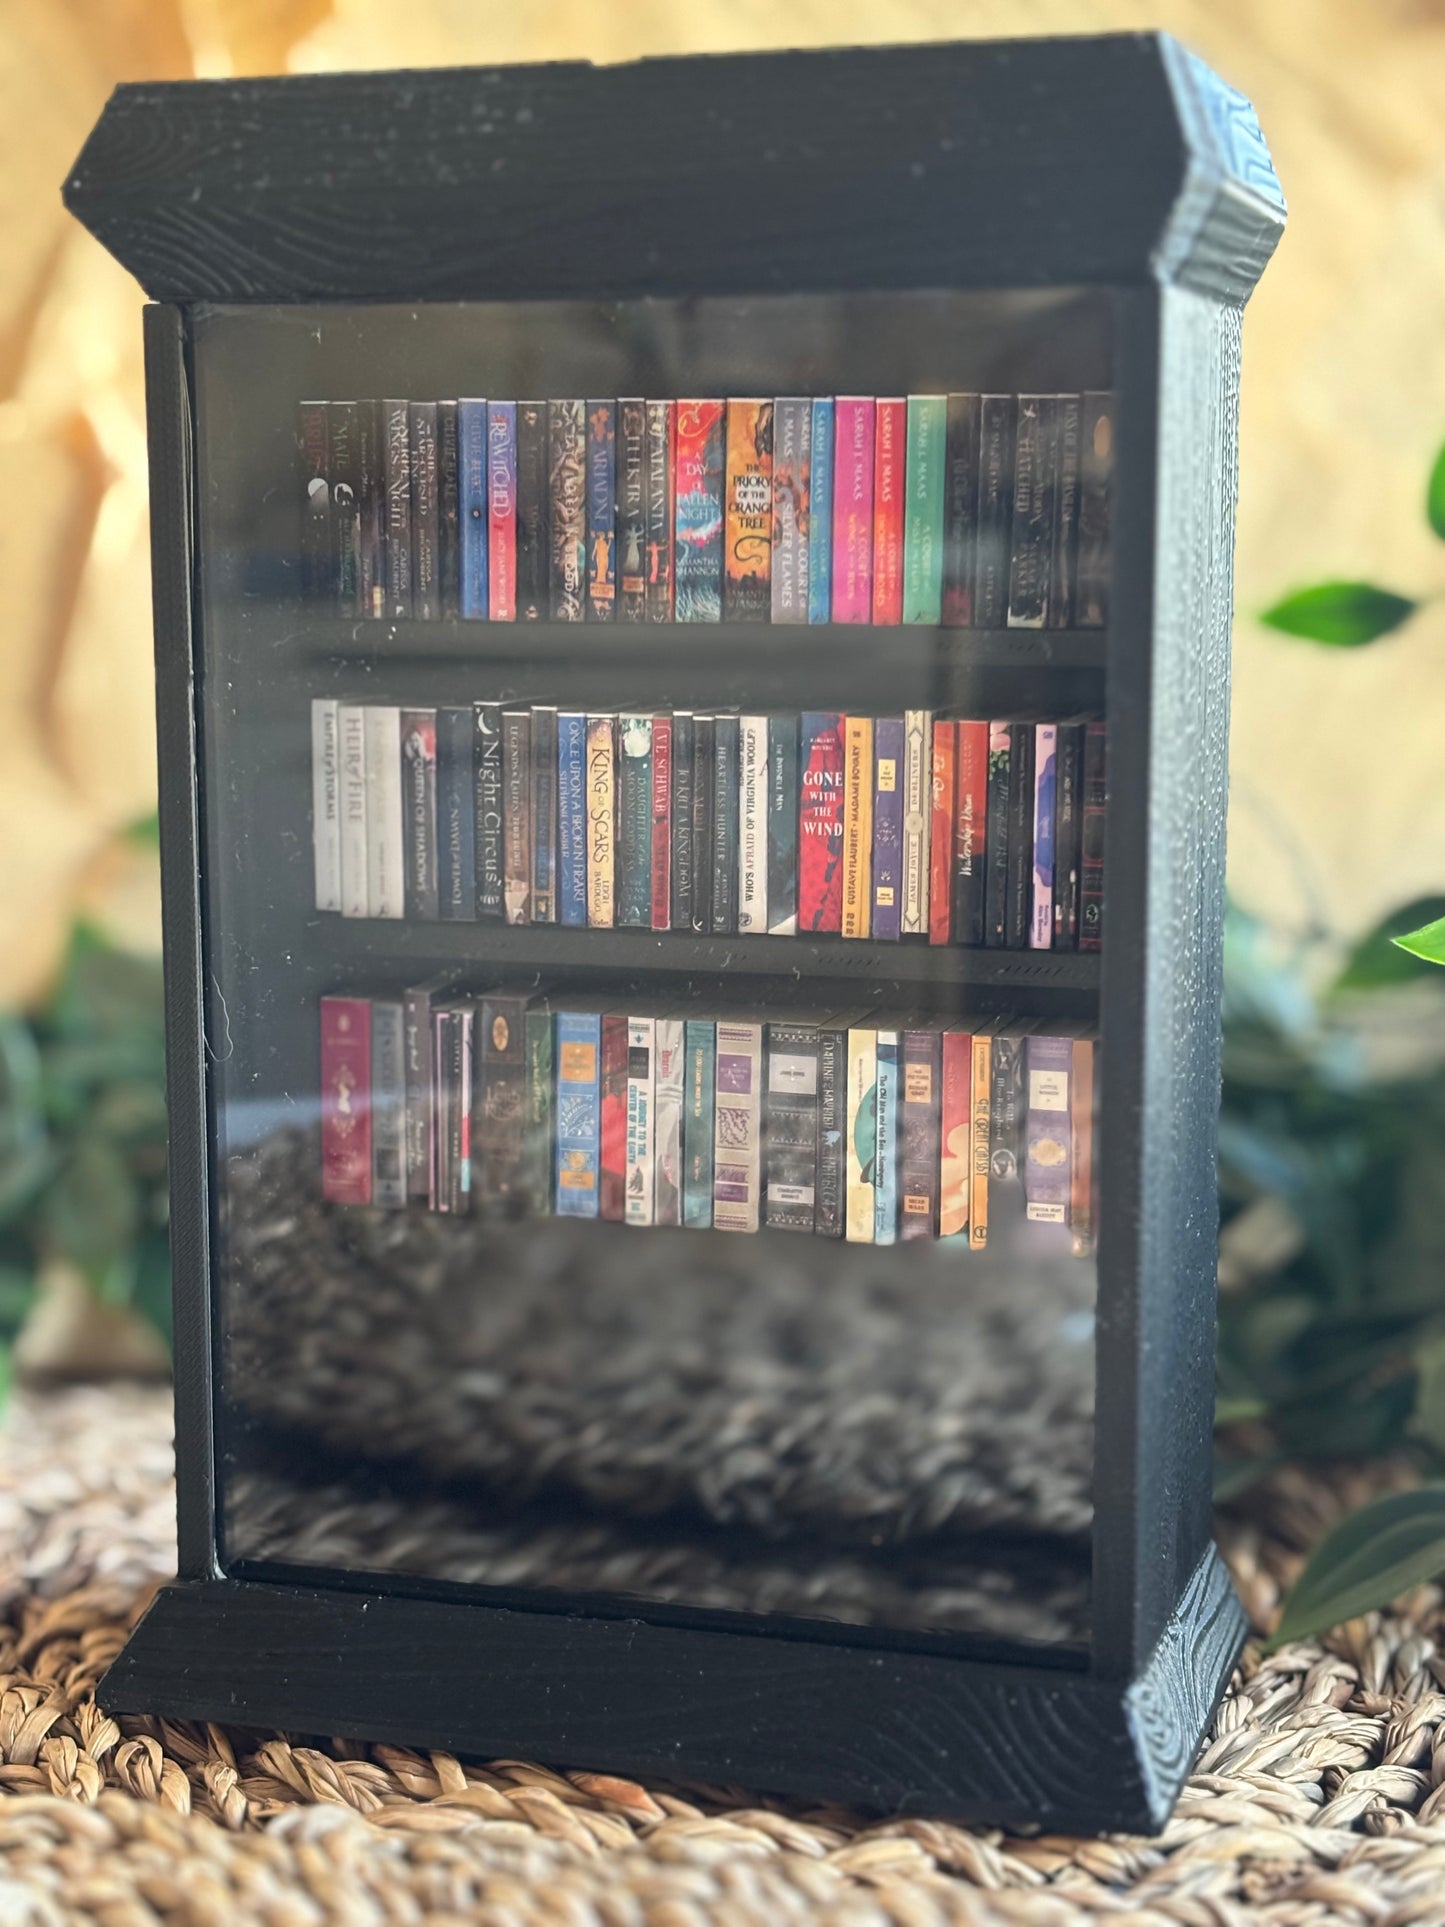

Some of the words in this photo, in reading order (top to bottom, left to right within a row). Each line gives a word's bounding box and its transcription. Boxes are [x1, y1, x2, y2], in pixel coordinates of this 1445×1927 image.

[387, 409, 402, 465] WINGS
[783, 420, 794, 458] MAAS
[801, 407, 810, 451] SARAH
[815, 411, 826, 452] SARAH
[853, 407, 864, 449] SARAH
[882, 407, 893, 450] SARAH
[490, 422, 512, 518] REWITCHED
[686, 464, 708, 476] DAY
[733, 476, 772, 489] PRIORY
[814, 467, 825, 504] MAAS
[852, 464, 863, 501] MAAS
[881, 464, 892, 503] MAAS
[916, 463, 927, 500] MAAS
[387, 478, 403, 531] NIGHT
[676, 493, 719, 506] FALLEN
[738, 490, 748, 499] OF
[751, 490, 765, 499] THE
[678, 508, 719, 521] NIGHT
[738, 518, 766, 530] TREE
[782, 502, 794, 549] SILVER
[391, 538, 400, 600] BROADBENT
[399, 548, 409, 590] CARISSA
[425, 539, 433, 582] CARISSA
[564, 546, 575, 593] BLOOD
[798, 548, 808, 596] COURT
[857, 537, 868, 578] COURT
[781, 553, 794, 609] FLAMES
[323, 712, 334, 758] EMPIRE
[345, 717, 362, 767] HEIR
[568, 721, 581, 757] ONCE
[745, 728, 757, 766] WOOLF?
[413, 758, 427, 804] QUEEN
[479, 741, 502, 806] Night
[570, 760, 582, 801] UPON
[590, 748, 611, 794] KING
[716, 746, 728, 810] HEARTLESS
[803, 770, 844, 787] GONE
[852, 745, 861, 781] BOVARY
[324, 768, 336, 821] STORMS
[346, 780, 363, 824] FIRE
[626, 769, 637, 811] MOON
[654, 757, 668, 813] SCHWAB
[745, 768, 757, 814] VIRGINIA
[809, 791, 837, 802] WITH
[851, 783, 860, 822] MADAME
[415, 806, 427, 822] OF
[572, 802, 582, 811] A
[636, 777, 648, 841] DAUGHTER
[677, 816, 689, 824] A
[745, 818, 756, 831] OF
[812, 806, 832, 818] THE
[483, 812, 503, 882] Circus
[572, 814, 584, 861] BROKEN
[590, 808, 611, 864] SCARS
[625, 815, 637, 873] GODDESS
[716, 814, 728, 862] HUNTER
[803, 821, 844, 837] WIND
[849, 828, 859, 868] FLAUBERT
[415, 826, 428, 892] SHADOWS
[676, 827, 692, 898] KINGDOM
[745, 833, 756, 870] AFRAID
[573, 863, 585, 904] HEART
[745, 872, 756, 902] WHO'S
[848, 869, 858, 905] GUSTAVE
[909, 873, 917, 904] JAMES
[628, 1084, 637, 1111] CENTER
[879, 1075, 888, 1086] The
[879, 1088, 888, 1099] Old
[628, 1114, 637, 1122] OF
[638, 1099, 647, 1128] JOURNEY
[878, 1101, 887, 1113] Man
[878, 1115, 888, 1125] and
[976, 1098, 990, 1114] THE
[992, 1076, 1005, 1141] Mockingbird
[628, 1126, 637, 1138] THE
[638, 1131, 647, 1140] TO
[878, 1127, 888, 1137] the
[878, 1139, 887, 1149] Sea
[975, 1117, 990, 1142] GREAT
[638, 1143, 647, 1156] THE
[975, 1146, 990, 1176] GATSBY
[876, 1154, 887, 1188] Hemingway
